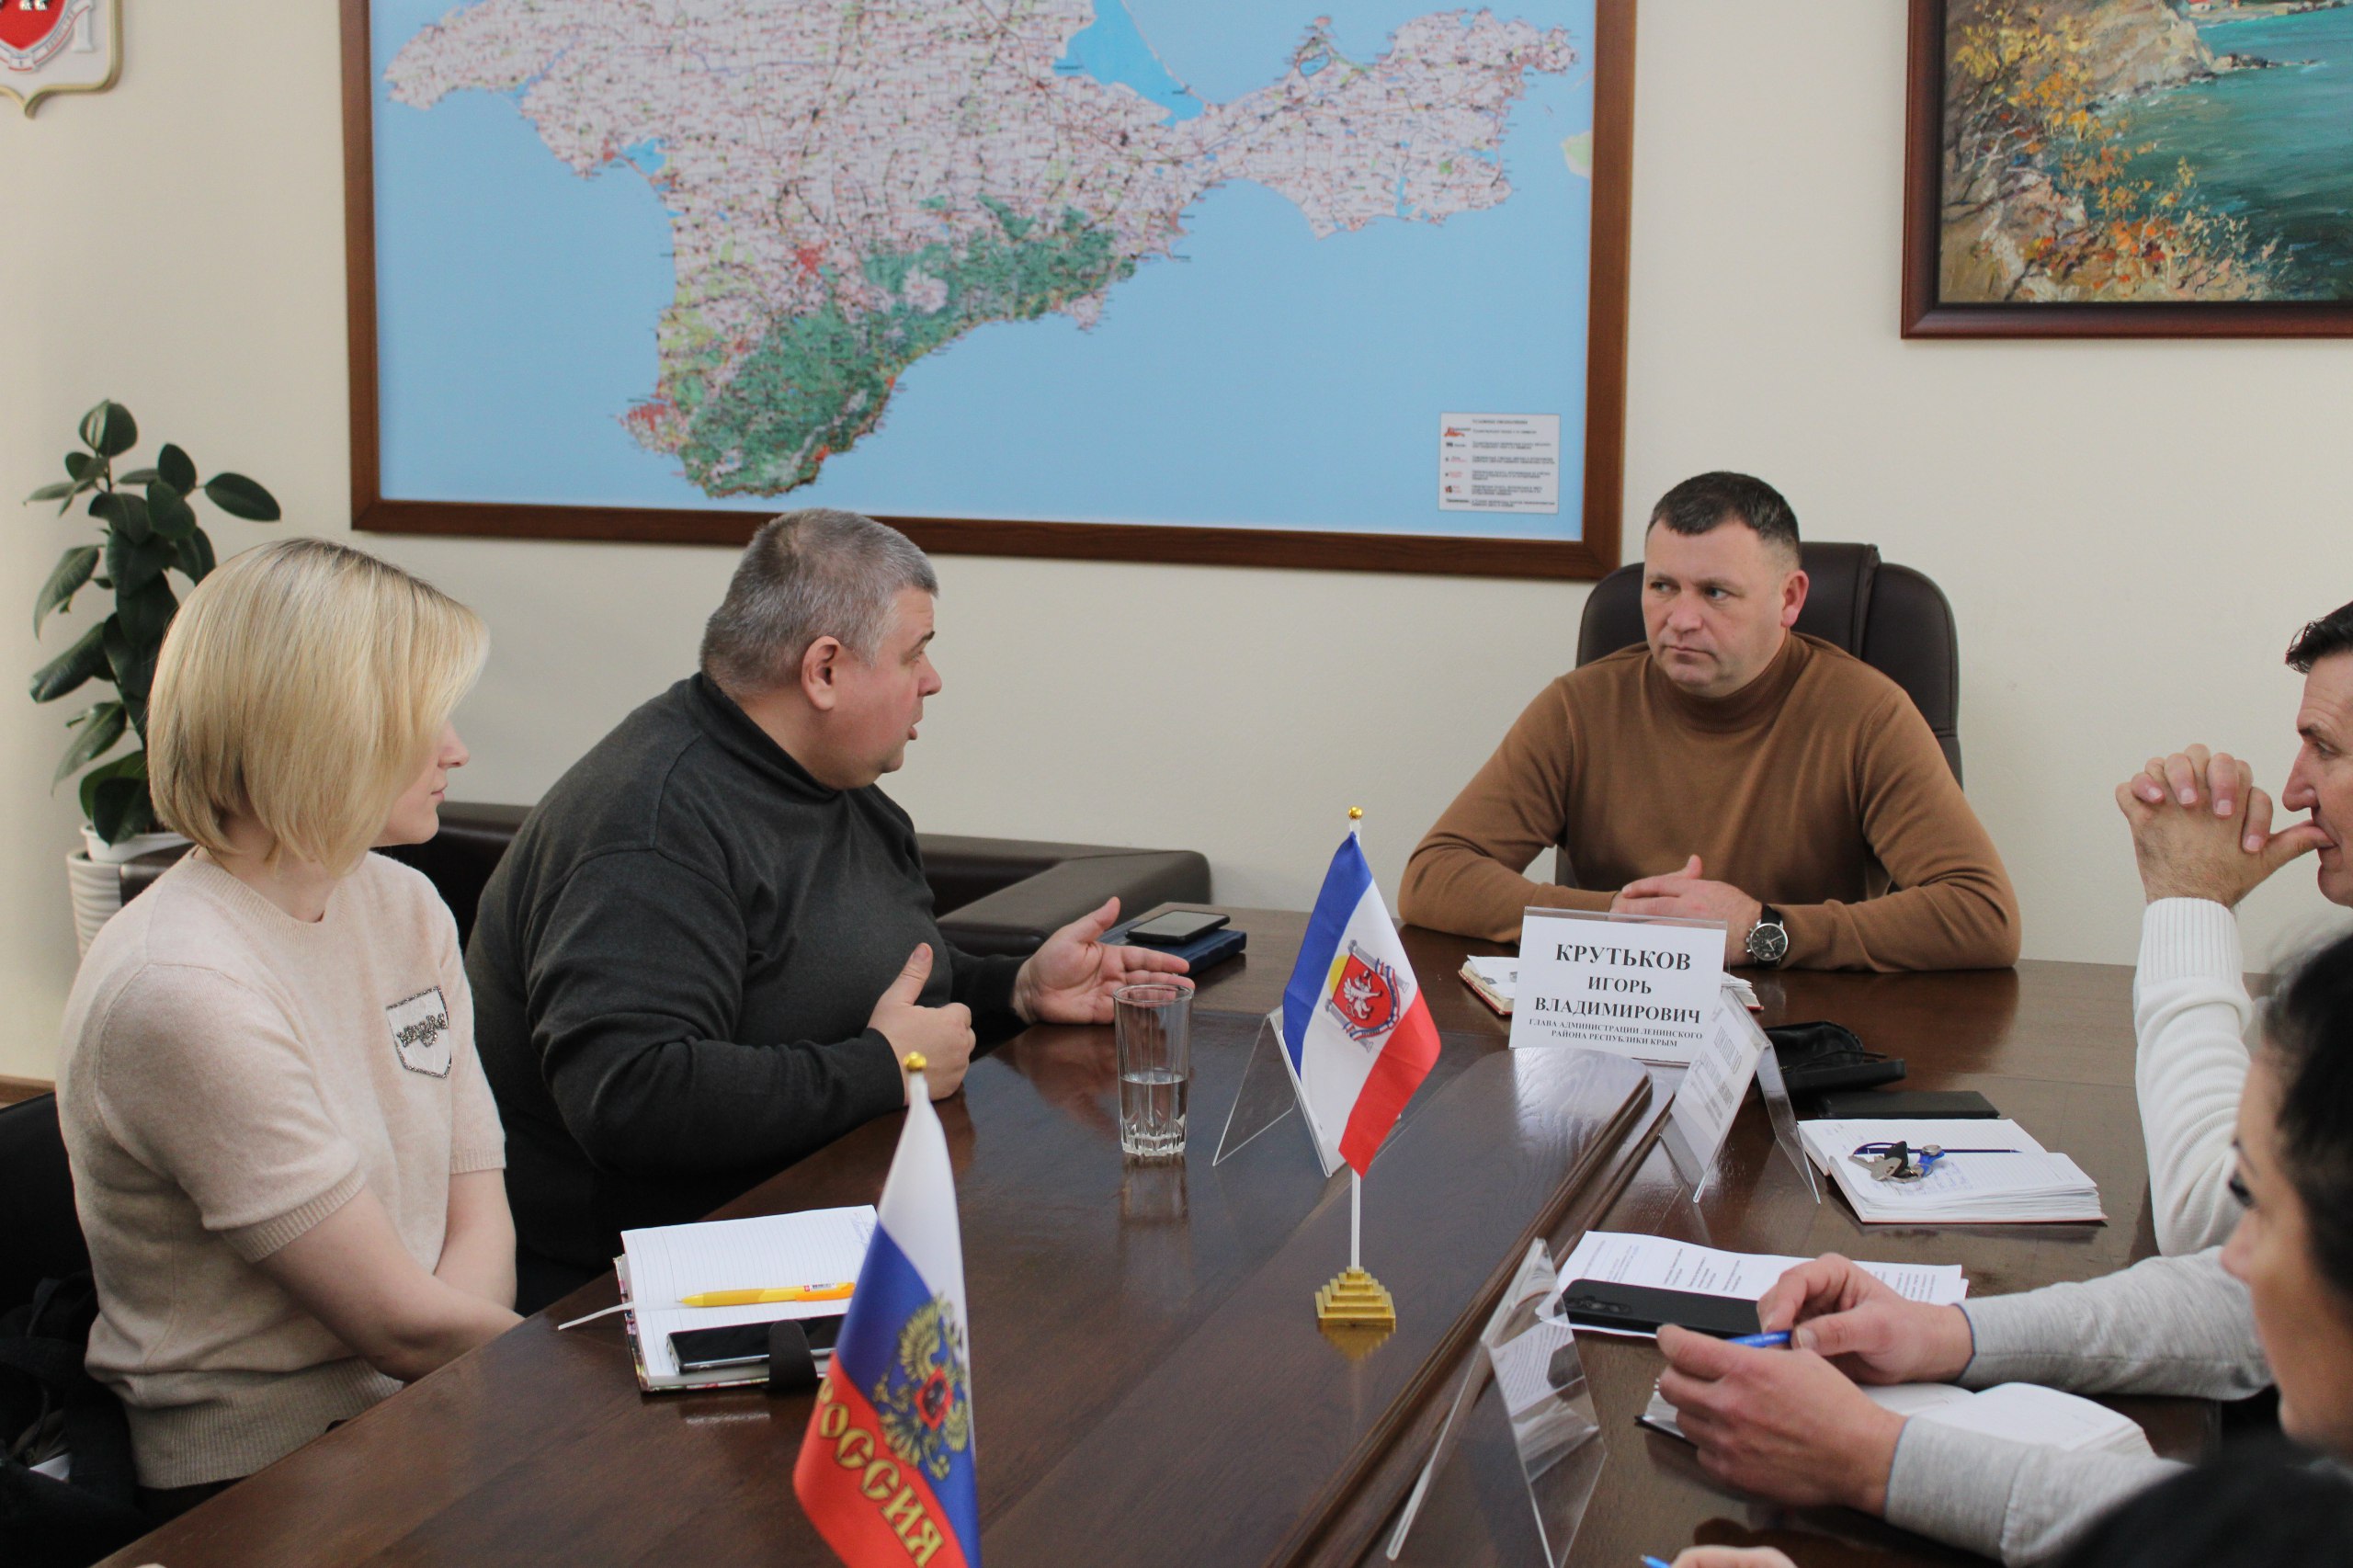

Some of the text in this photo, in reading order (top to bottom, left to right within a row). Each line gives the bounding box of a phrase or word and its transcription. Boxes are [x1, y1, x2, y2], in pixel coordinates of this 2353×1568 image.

[1556, 944, 1690, 971] КРУТЬКОВ
[1588, 976, 1651, 994] ИГОРЬ
[1535, 997, 1699, 1024] ВЛАДИМИРОВИЧ
[1529, 1018, 1702, 1040] ГЛАВА АДМИНИСТРАЦИИ ЛЕНИНСКОГО
[1552, 1029, 1677, 1047] РАЙОНА РЕСПУБЛИКИ КРЫМ
